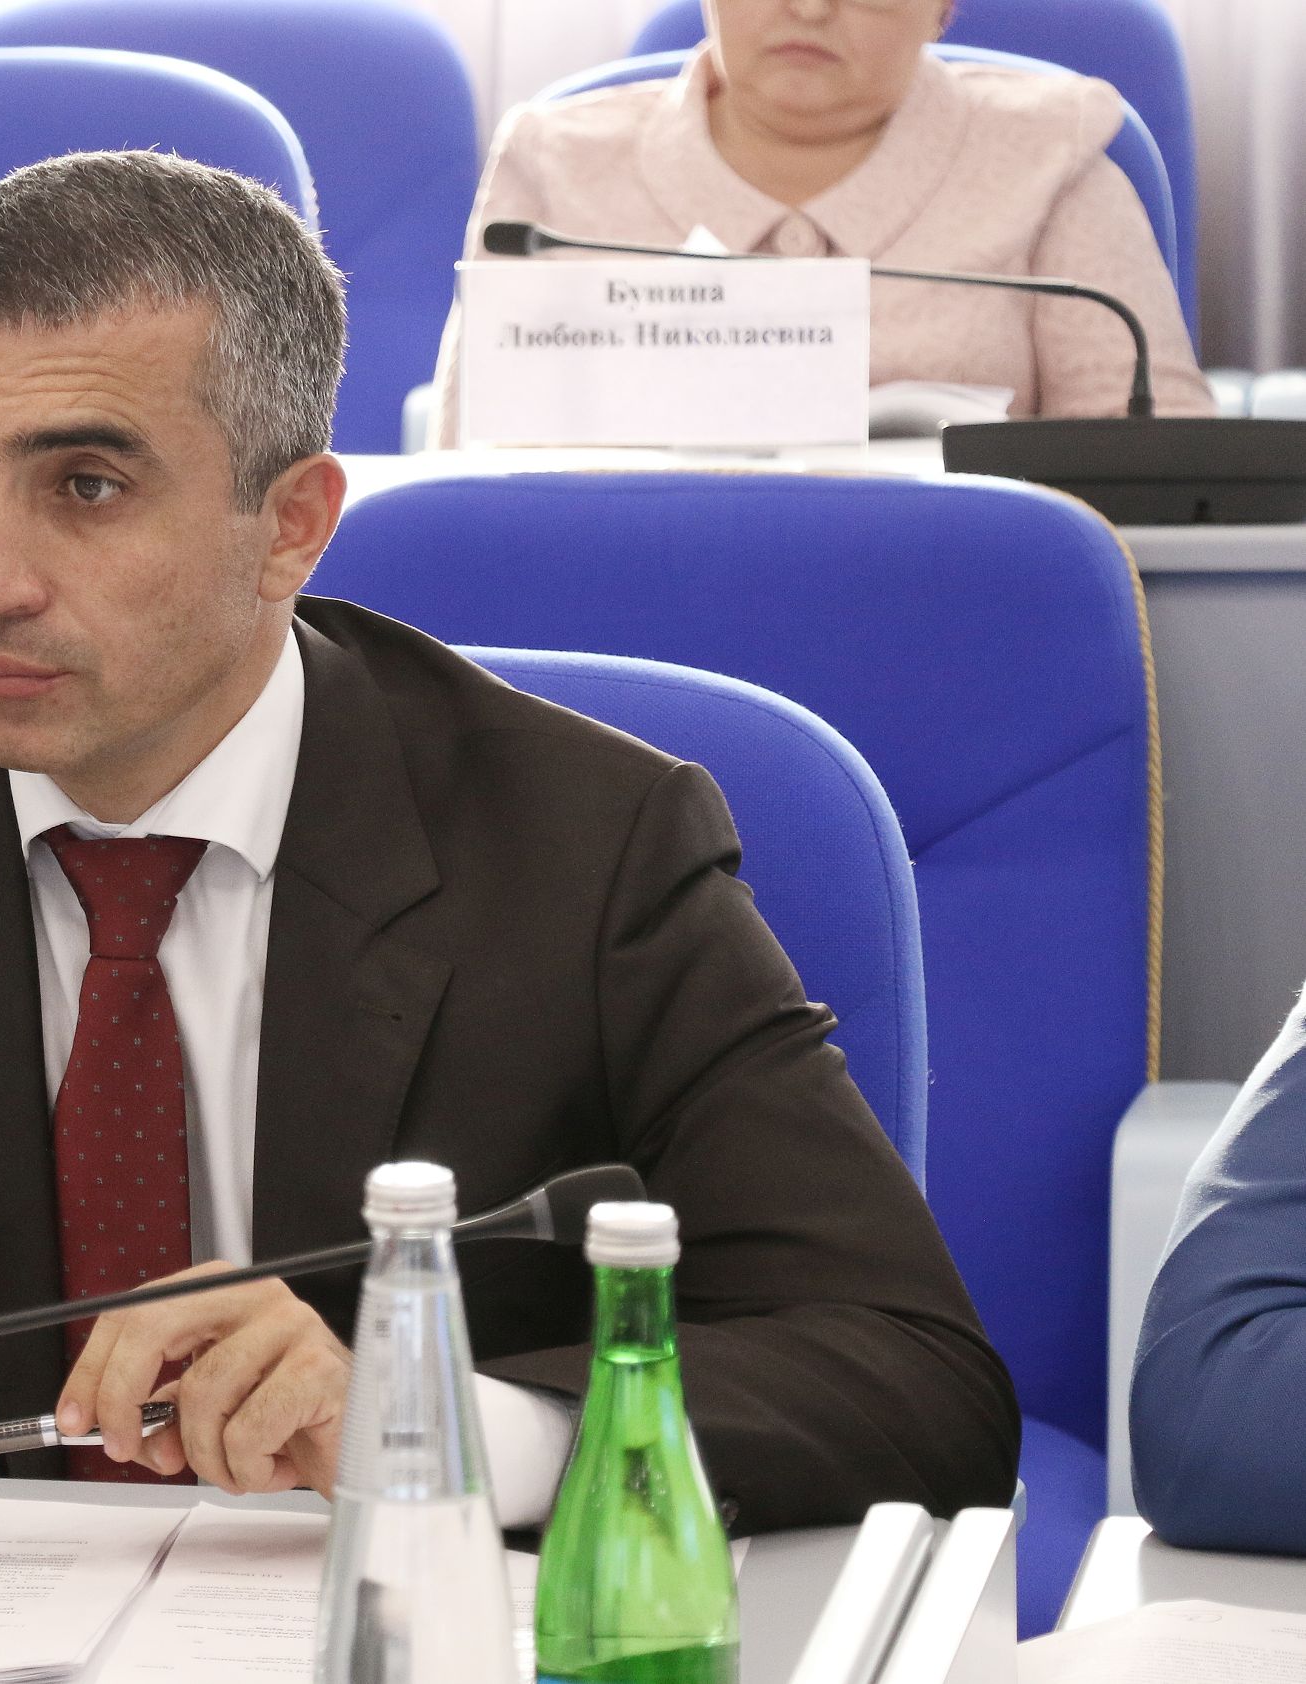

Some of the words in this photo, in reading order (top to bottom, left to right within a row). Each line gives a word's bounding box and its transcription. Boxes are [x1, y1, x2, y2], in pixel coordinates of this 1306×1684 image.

[606, 278, 725, 310] Бунина
[498, 322, 624, 349] Любовь
[637, 321, 835, 347] Николаевна
